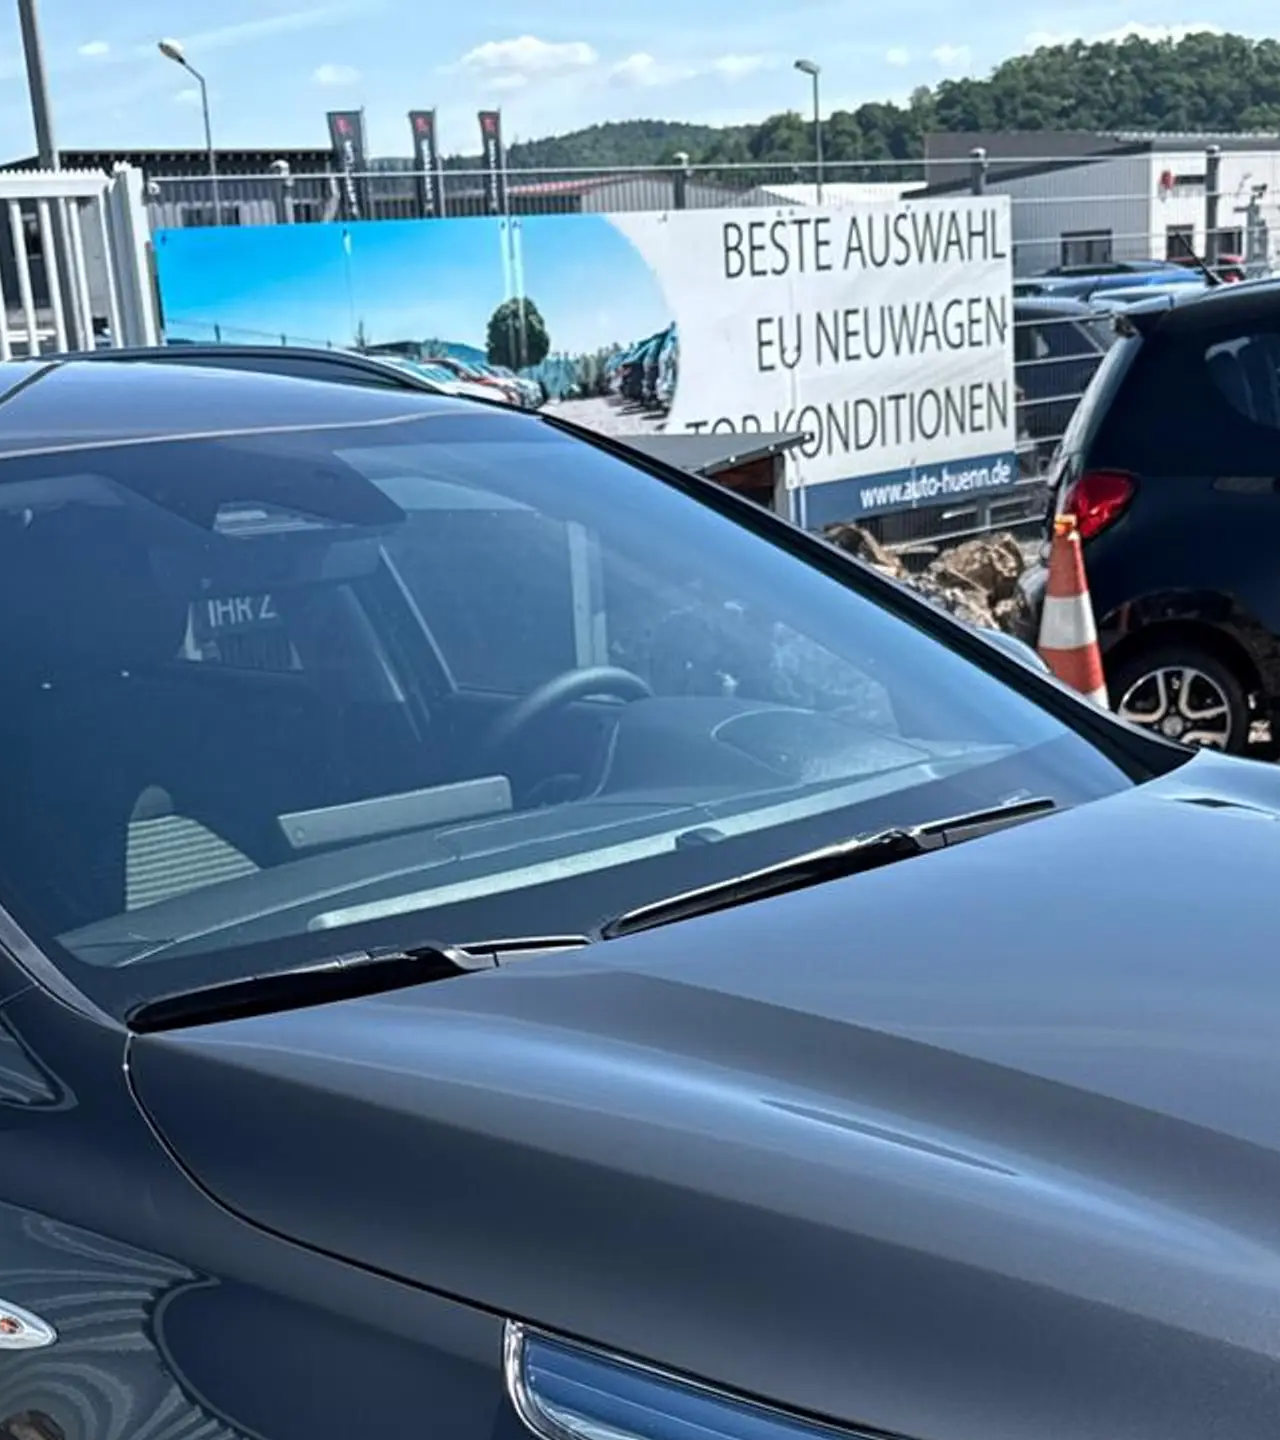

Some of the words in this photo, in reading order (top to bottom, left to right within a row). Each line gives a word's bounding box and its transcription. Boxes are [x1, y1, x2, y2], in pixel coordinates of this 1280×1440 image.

[723, 217, 832, 278] BESTE
[843, 208, 1007, 270] AUSWAHL
[756, 313, 802, 372] EU
[816, 295, 1007, 366] NEUWAGEN
[860, 461, 1011, 509] www.auto-huenn.de
